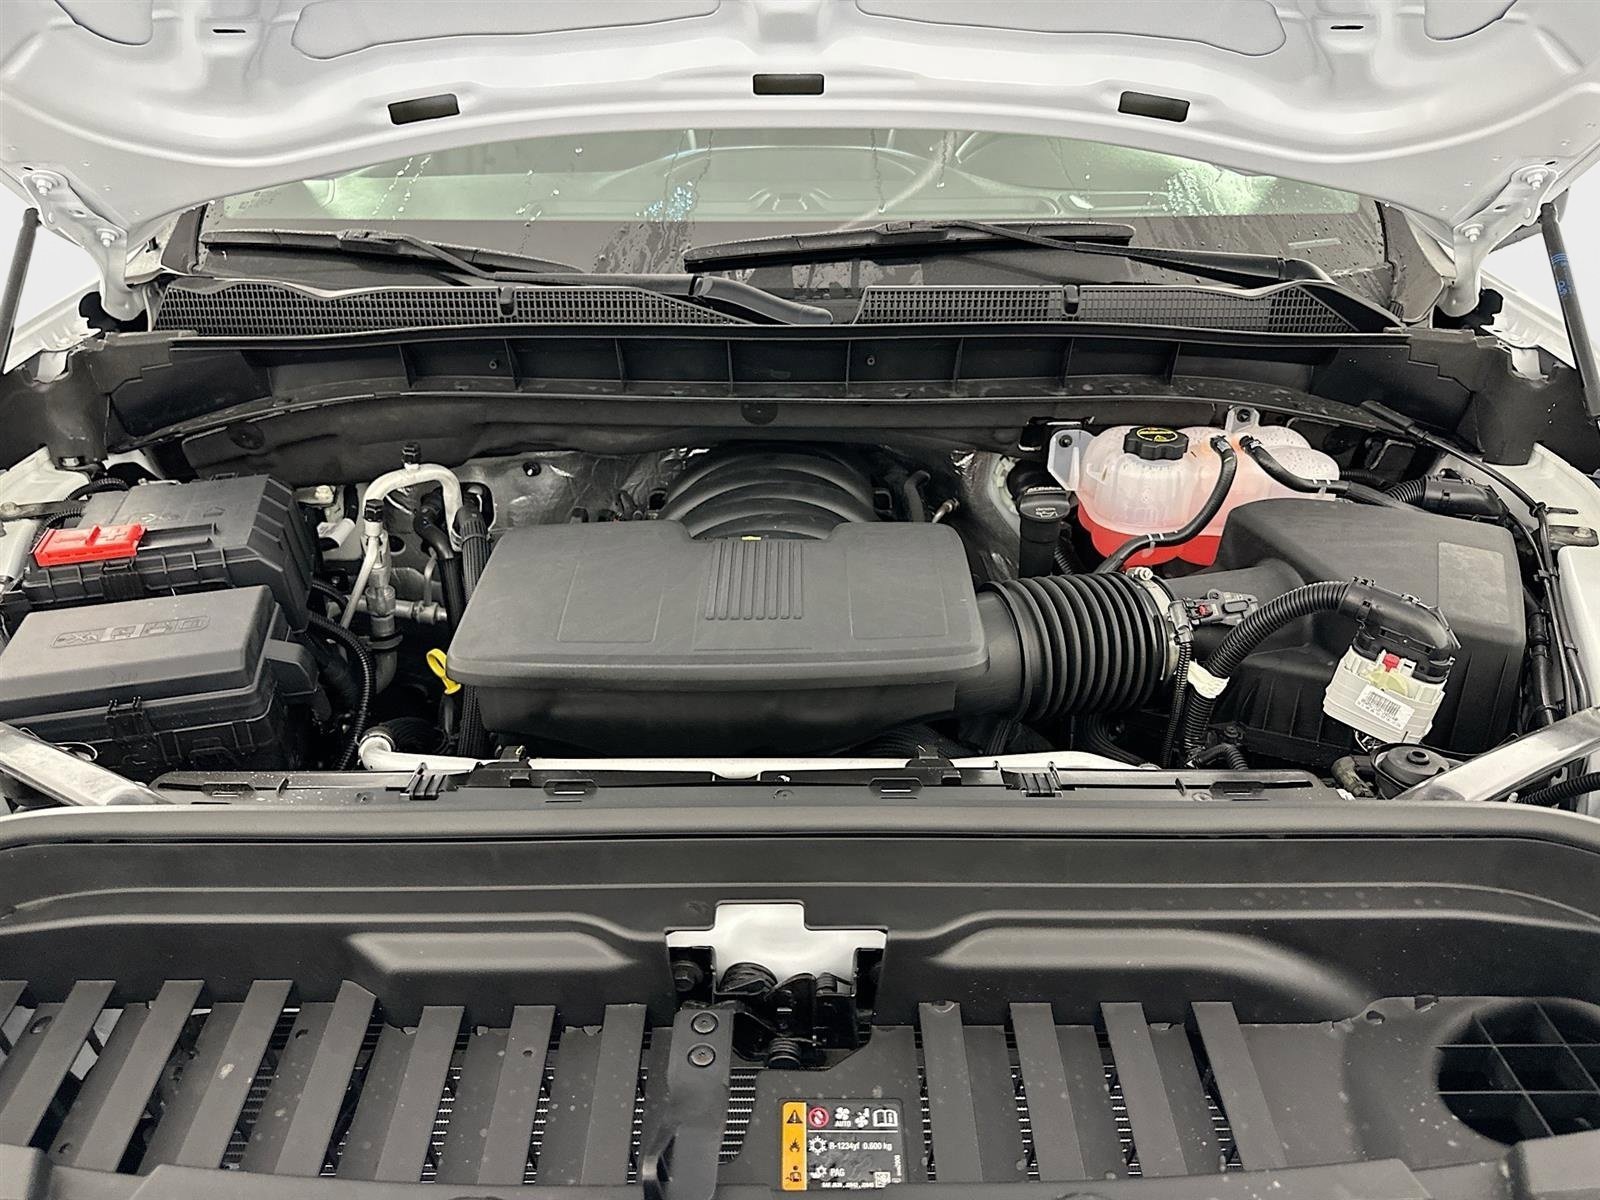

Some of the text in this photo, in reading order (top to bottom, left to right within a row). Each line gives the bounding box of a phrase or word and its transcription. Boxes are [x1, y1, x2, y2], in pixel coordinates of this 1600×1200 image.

[829, 1142, 860, 1151] R-1234yf
[883, 1142, 893, 1151] kg
[830, 1168, 846, 1177] PAG
